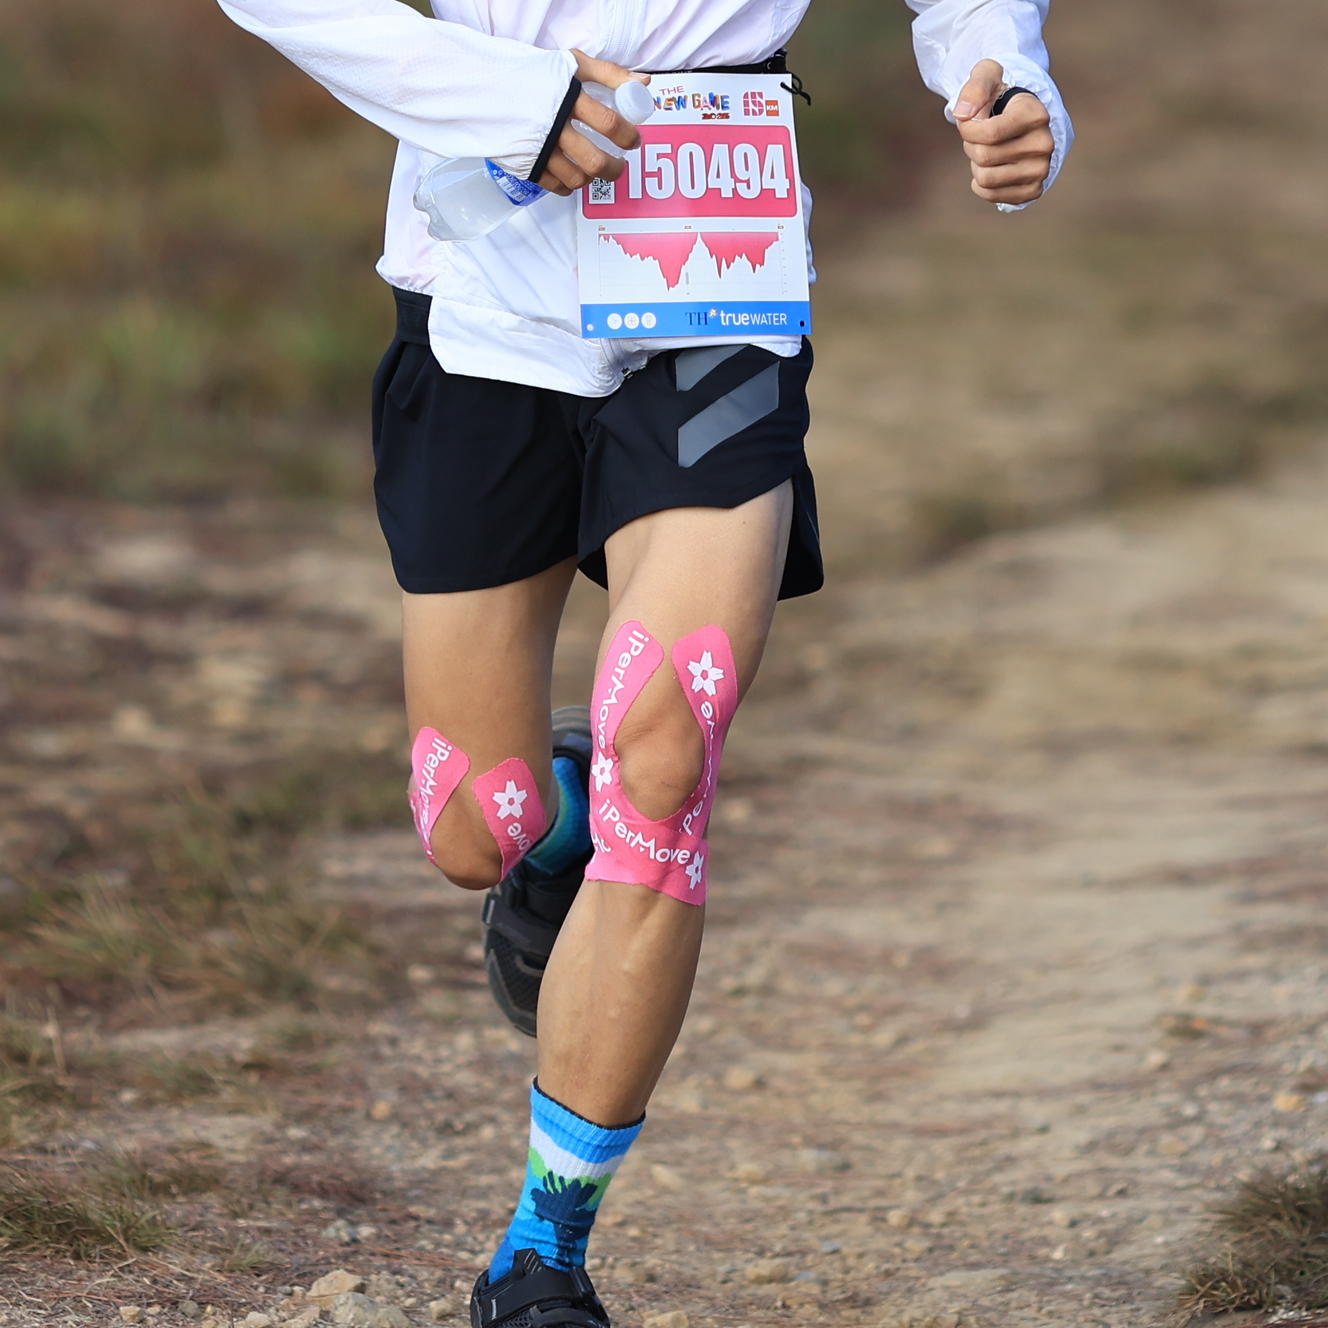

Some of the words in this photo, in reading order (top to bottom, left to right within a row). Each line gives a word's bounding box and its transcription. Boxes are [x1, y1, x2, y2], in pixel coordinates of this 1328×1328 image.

[659, 85, 684, 95] THE
[653, 94, 688, 111] NEW
[692, 92, 730, 111] GAME
[766, 103, 779, 111] KM
[624, 143, 790, 199] 150494
[685, 312, 708, 326] TH
[598, 628, 649, 750] iPerMove
[598, 799, 691, 863] iPerMove
